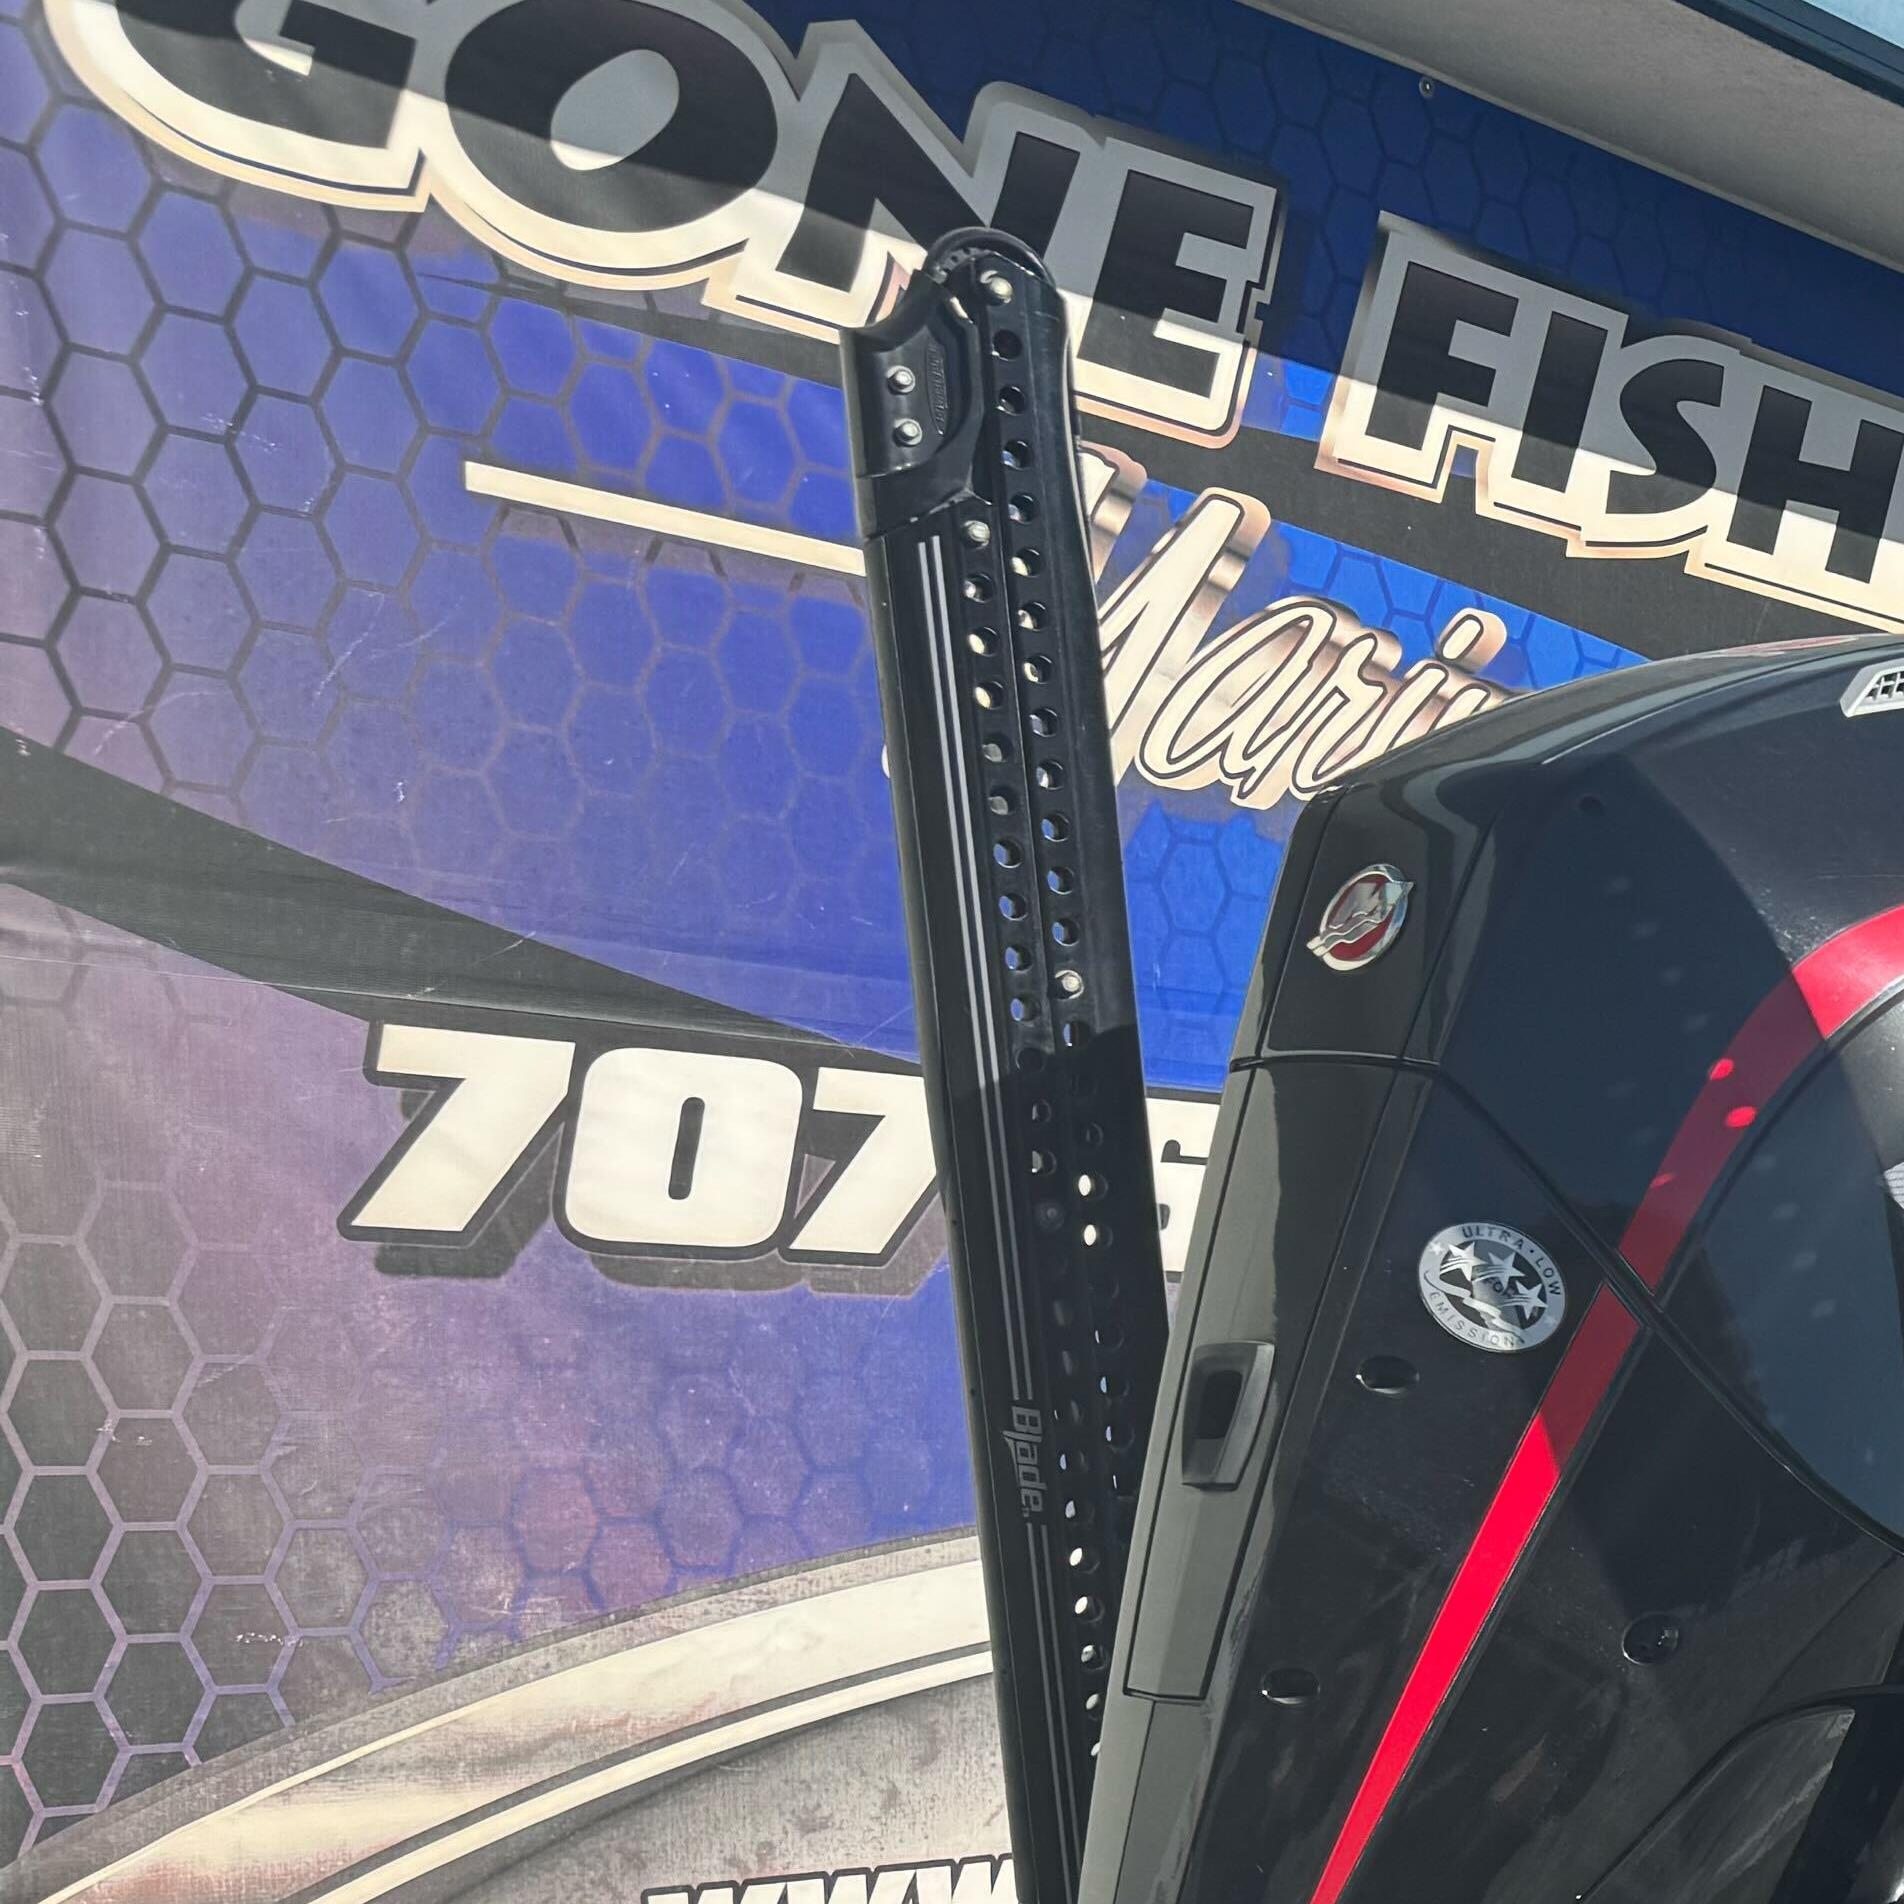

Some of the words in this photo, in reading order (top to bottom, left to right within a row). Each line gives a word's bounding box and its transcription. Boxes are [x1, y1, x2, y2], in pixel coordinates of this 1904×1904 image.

[80, 0, 1270, 425] GONE
[345, 1020, 938, 1260] 707
[1460, 1224, 1525, 1252] ULTRA
[1534, 1256, 1562, 1297] LOW
[1001, 1405, 1045, 1513] Blade
